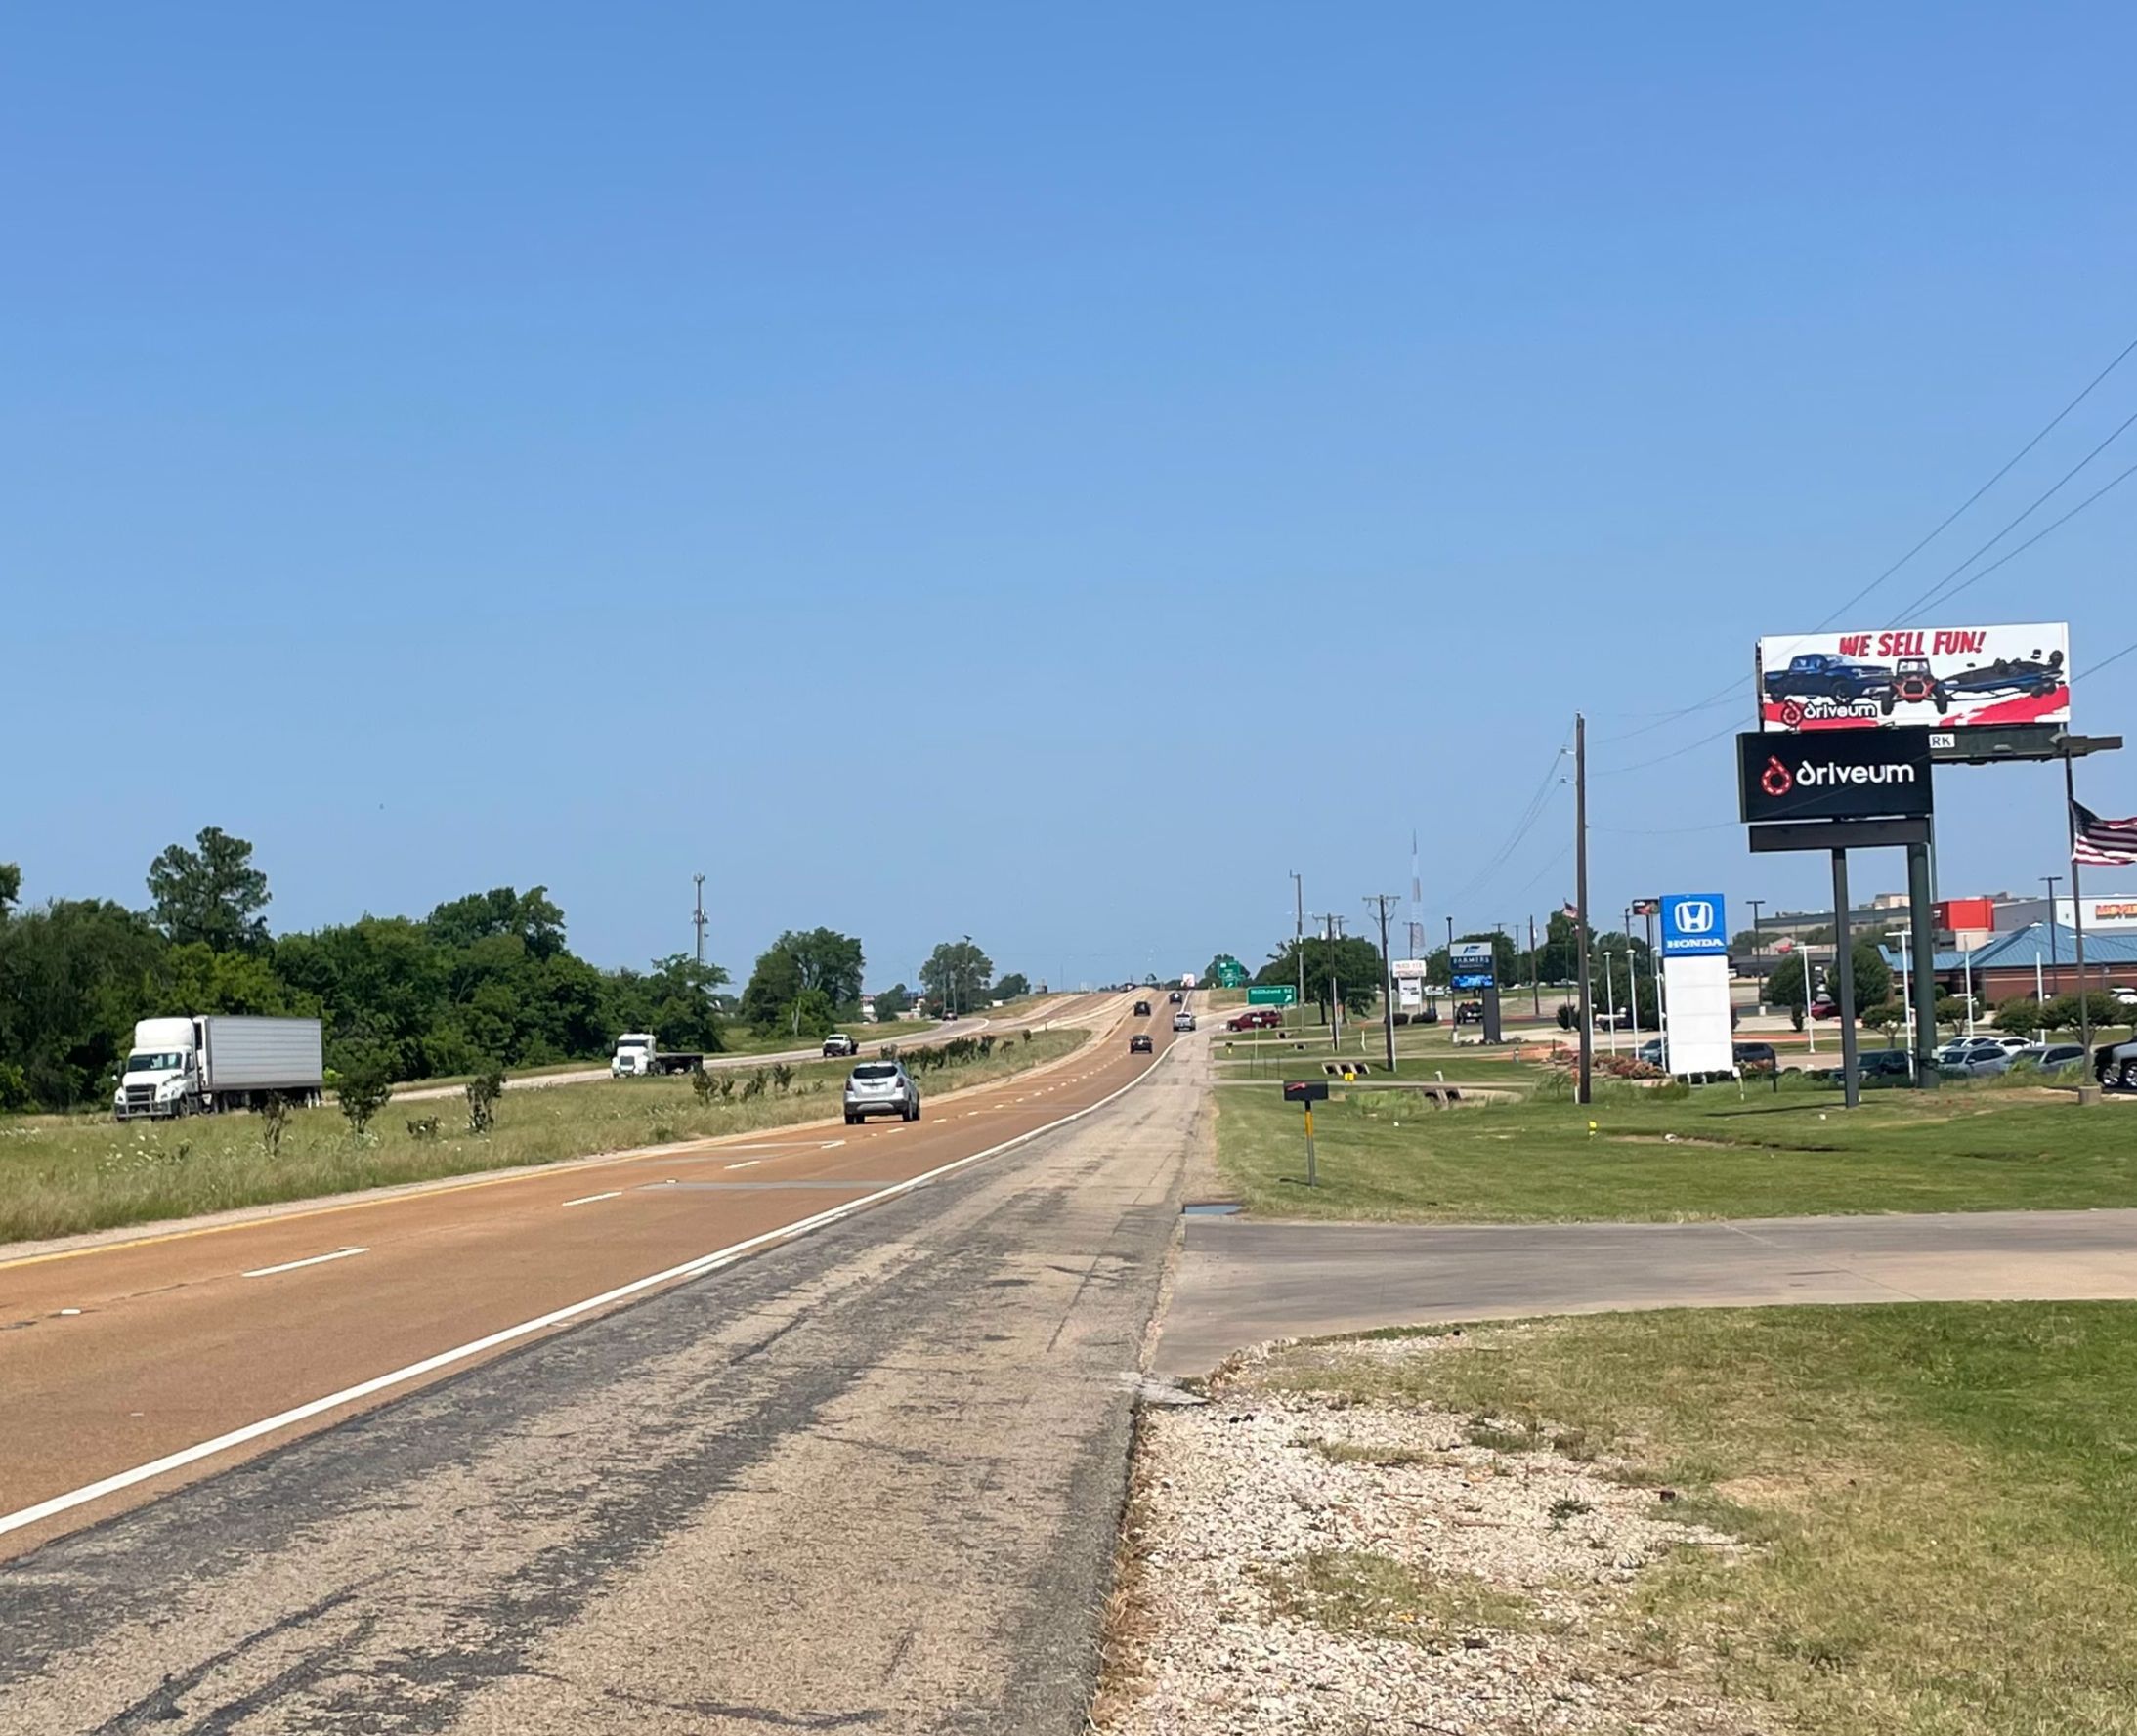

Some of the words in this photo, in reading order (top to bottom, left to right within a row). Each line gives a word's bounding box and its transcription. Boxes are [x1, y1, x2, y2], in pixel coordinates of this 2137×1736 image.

[1839, 635, 1872, 657] WE
[1877, 631, 1925, 657] SELL
[1932, 631, 1987, 656] FUN!
[1804, 702, 1877, 719] driveum
[1796, 759, 1915, 786] driveum
[1666, 939, 1725, 949] HONDA
